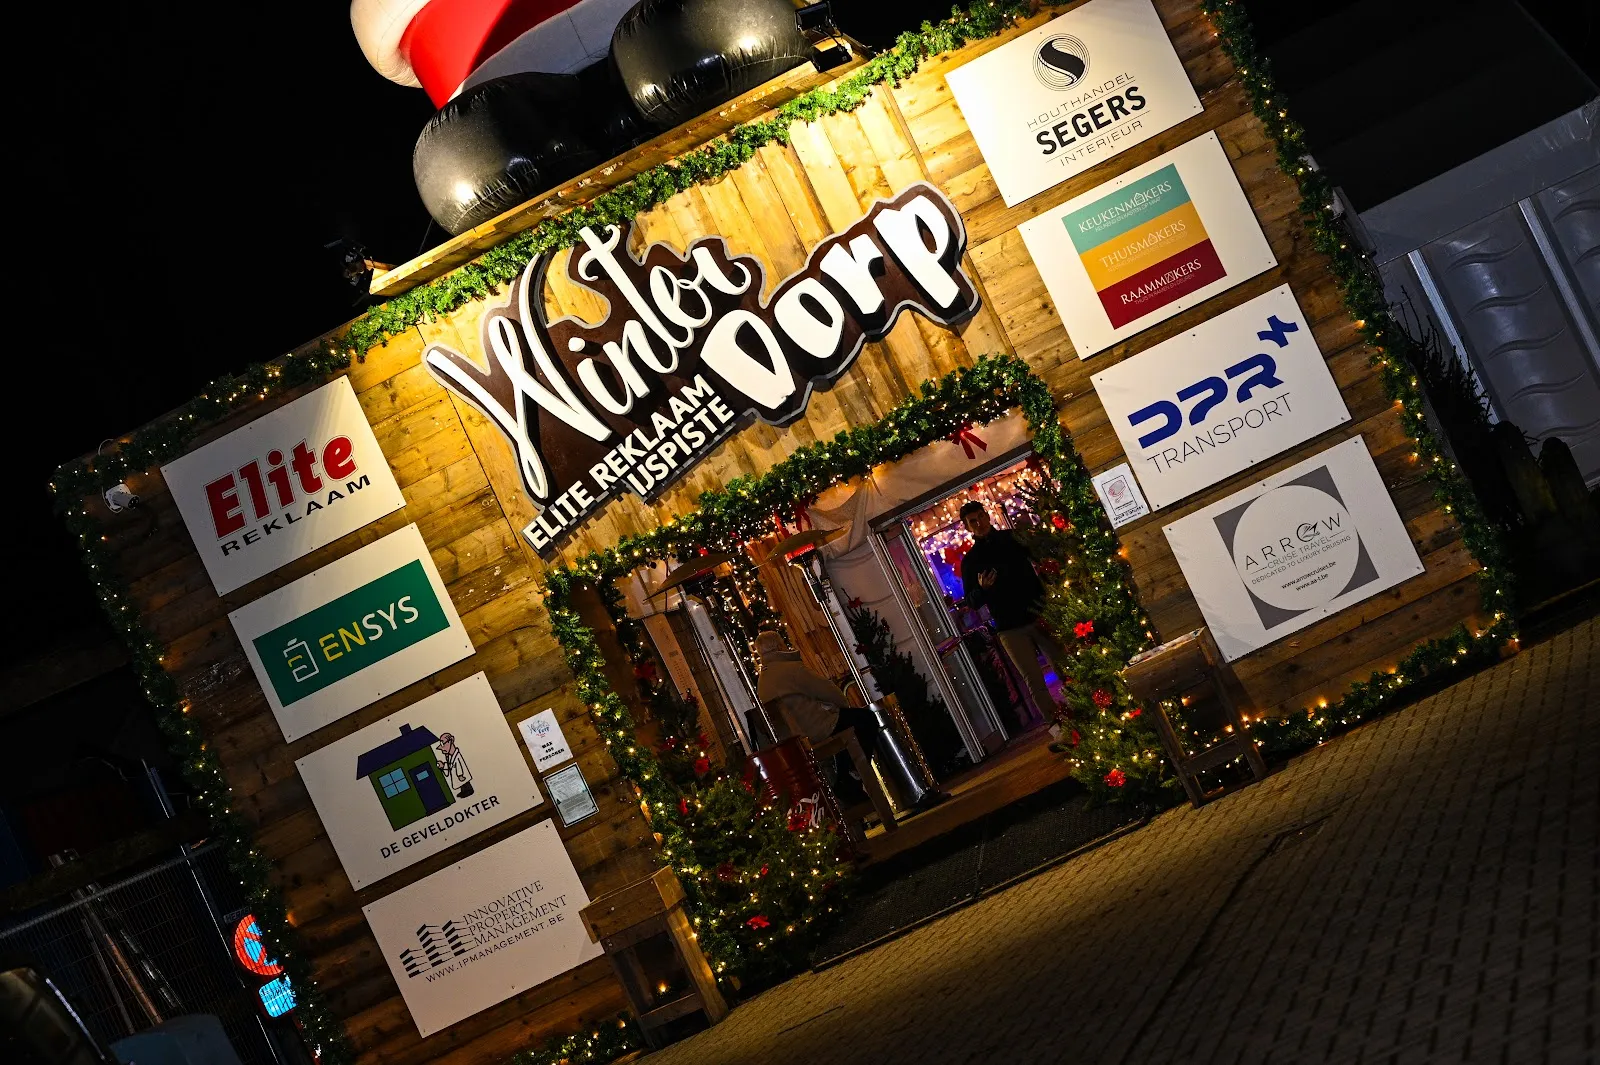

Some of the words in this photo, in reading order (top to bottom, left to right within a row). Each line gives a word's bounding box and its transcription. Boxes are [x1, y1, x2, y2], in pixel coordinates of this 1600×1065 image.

[1026, 72, 1136, 129] HOUTHANDEL
[1036, 86, 1146, 155] SEGERS
[1060, 120, 1143, 166] INTERIEUR
[699, 195, 962, 409] Dorp
[427, 224, 751, 499] Winter
[522, 480, 594, 550] ELITE
[588, 373, 715, 491] REKLAAM
[626, 395, 735, 496] IJSPISTE
[1146, 392, 1292, 474] TRANSPORT
[204, 435, 359, 541] Elite
[220, 474, 371, 557] REKLAAM
[1251, 565, 1287, 585] DEDICATED
[1287, 560, 1296, 568] TO
[1297, 550, 1321, 564] LUXURY
[1321, 535, 1351, 552] CRUISING
[1267, 550, 1298, 569] CRUISE
[1299, 536, 1330, 554] TRAVEL
[318, 595, 419, 662] ENSYS
[380, 839, 401, 859] DE
[402, 795, 501, 849] GEVELDOKTER
[463, 880, 544, 926] INNOVATIVE
[469, 898, 535, 936] PROPERTY
[473, 894, 568, 947] MANAGEMENT
[425, 913, 565, 983] WWW.IPMANAGEMENT.BE
